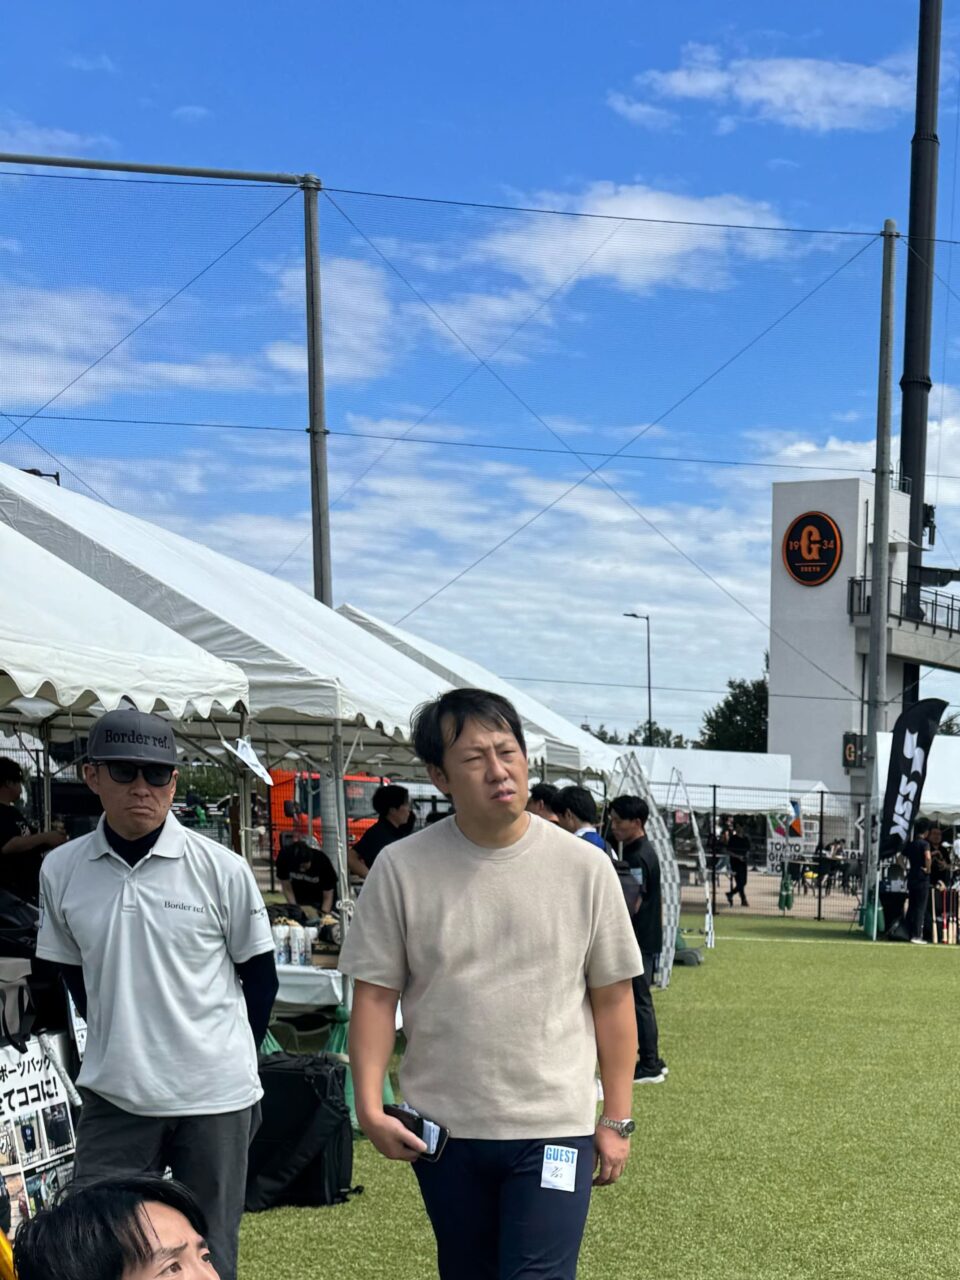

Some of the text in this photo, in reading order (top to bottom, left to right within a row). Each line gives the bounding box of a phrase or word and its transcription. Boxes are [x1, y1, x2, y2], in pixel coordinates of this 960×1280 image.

[104, 729, 151, 746] Border
[889, 774, 918, 841] SSK
[164, 901, 192, 912] Border
[545, 1147, 576, 1165] GUEST
